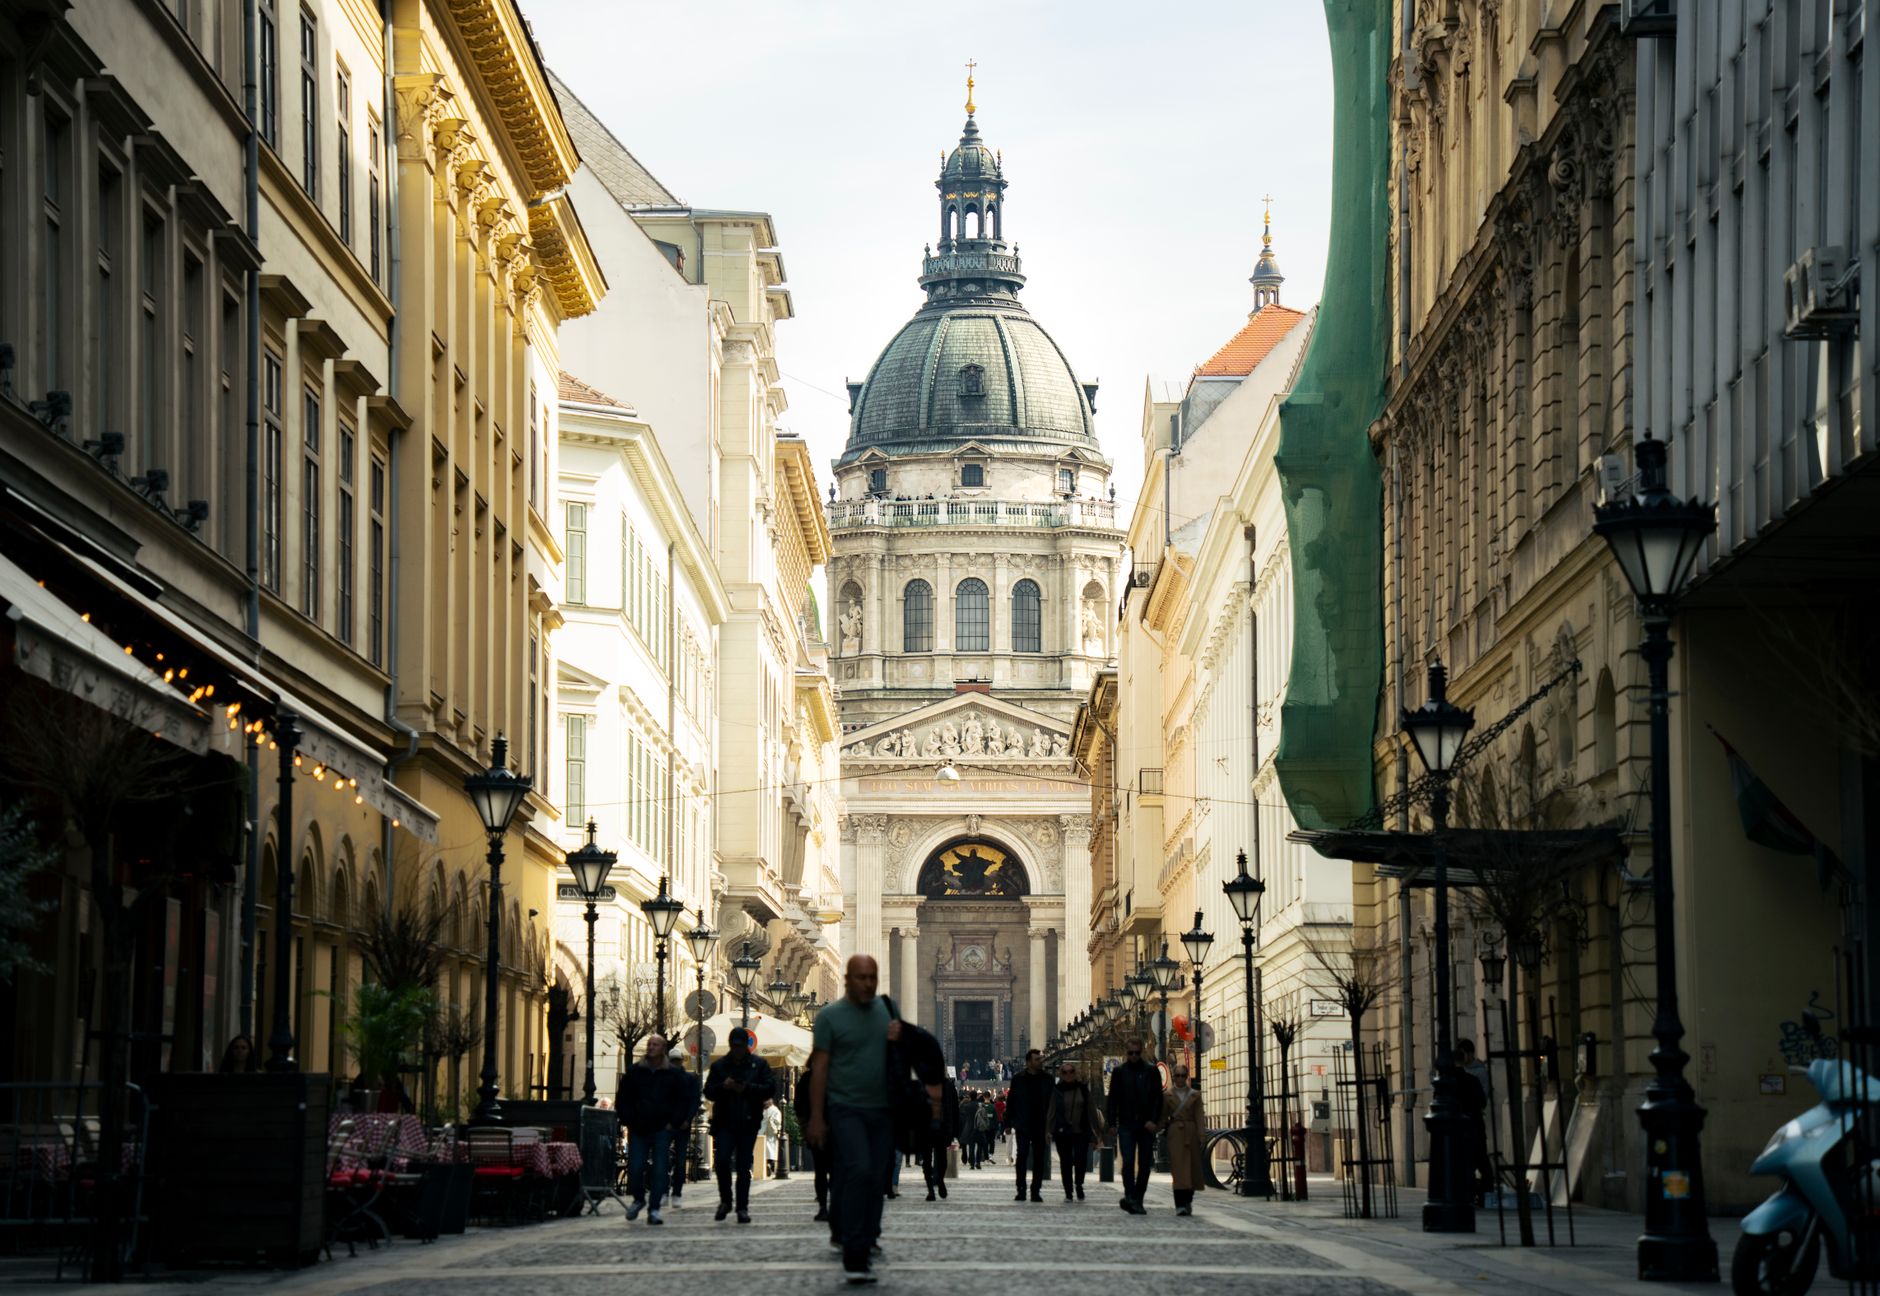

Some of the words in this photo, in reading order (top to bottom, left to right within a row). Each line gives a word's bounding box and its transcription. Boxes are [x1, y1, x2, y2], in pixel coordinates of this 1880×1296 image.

[872, 781, 897, 792] EGO
[904, 782, 933, 792] SUM
[969, 782, 1019, 792] VERITAS
[1026, 782, 1041, 792] ET
[1048, 782, 1075, 792] VITA
[559, 887, 613, 900] CENLIS
